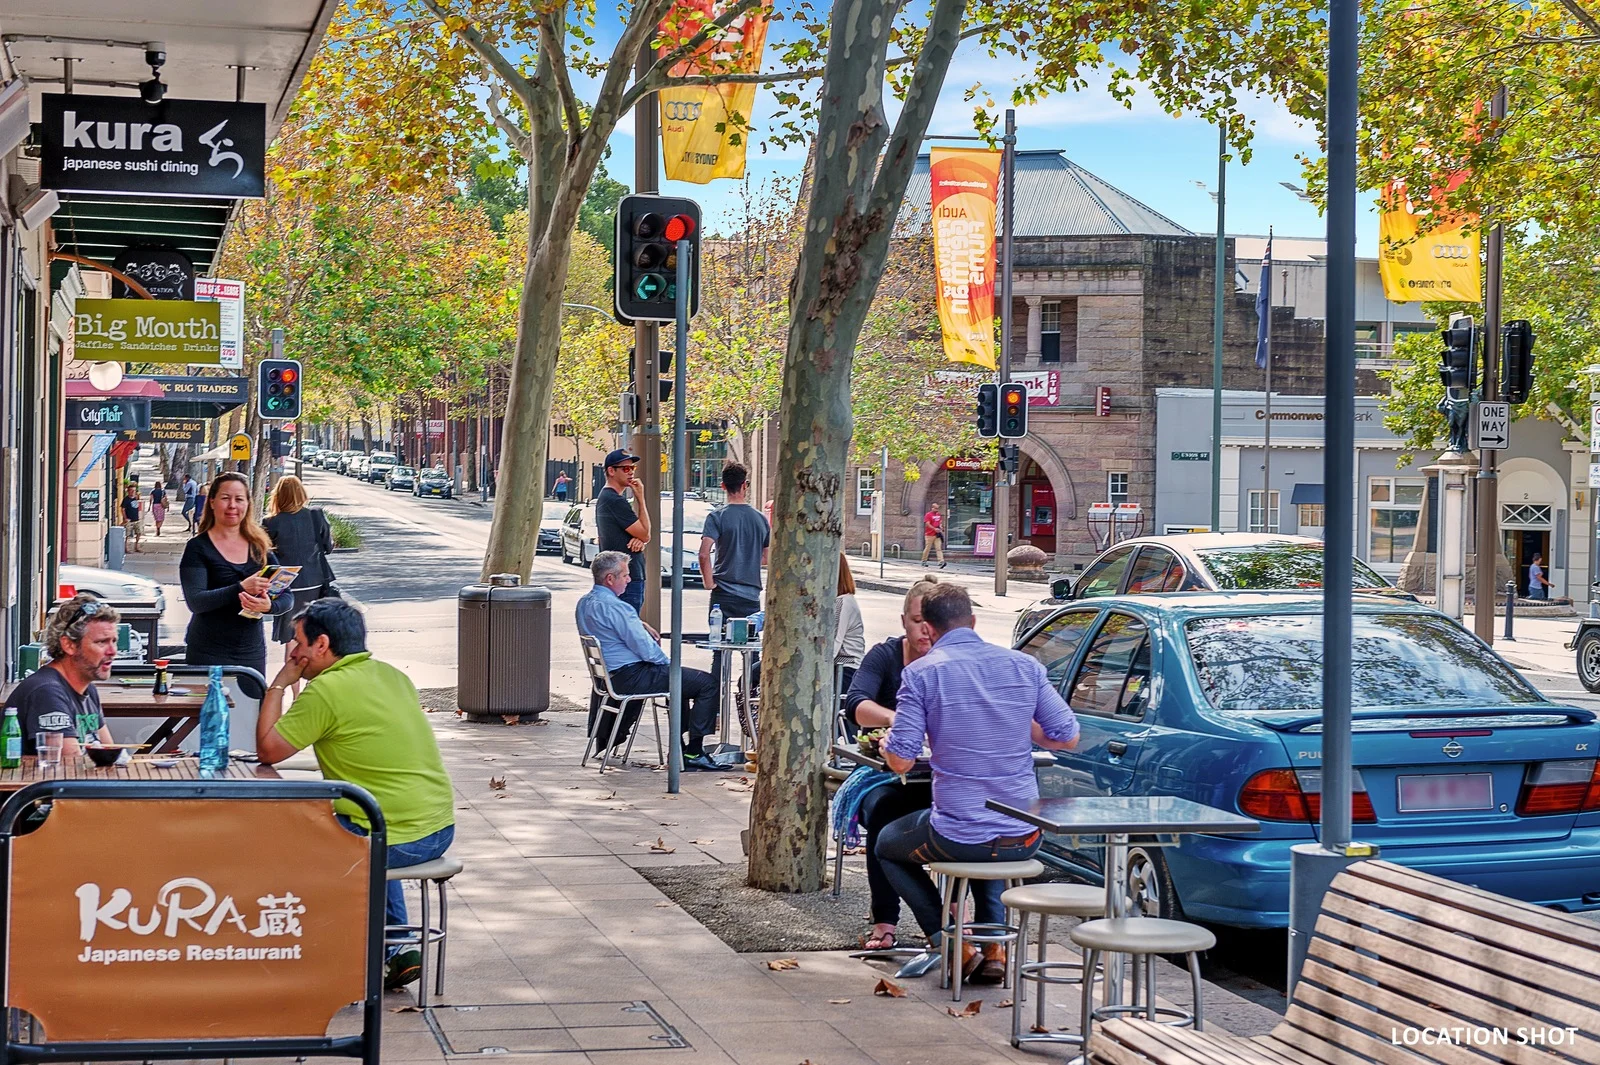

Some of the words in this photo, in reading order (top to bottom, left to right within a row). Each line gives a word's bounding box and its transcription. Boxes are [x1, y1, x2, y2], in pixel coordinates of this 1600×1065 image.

[63, 110, 183, 152] kura
[62, 157, 122, 171] japanese
[124, 159, 158, 172] sushi
[160, 160, 199, 176] dining
[75, 313, 128, 341] Big
[134, 316, 219, 340] Mouth
[75, 340, 114, 350] Jaffles
[120, 341, 177, 351] Sandwiches
[183, 343, 219, 352] Drinks
[174, 383, 194, 393] RUG
[196, 384, 239, 394] TRADERS
[81, 405, 123, 425] CityFlair
[1483, 406, 1505, 418] ONE
[183, 423, 201, 431] RUG
[1481, 421, 1506, 432] WAY
[152, 430, 192, 440] TRADERS
[1523, 492, 1529, 500] 2
[1575, 743, 1588, 751] LX
[78, 946, 181, 965] Japanese
[186, 944, 302, 961] Restaurant
